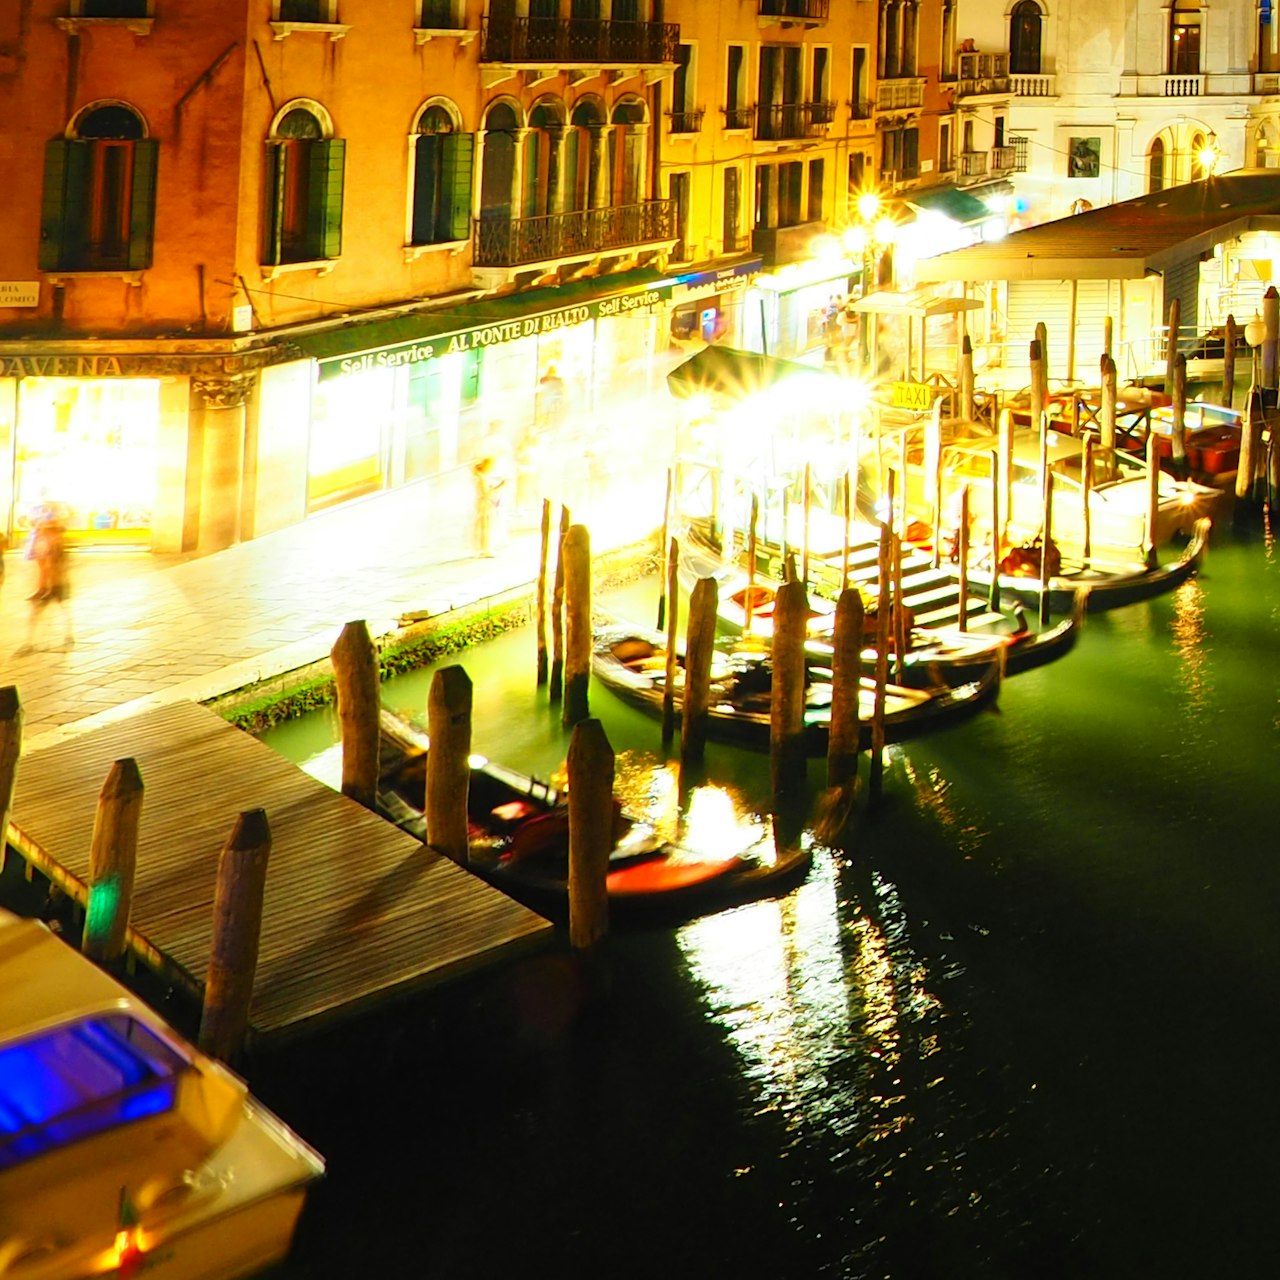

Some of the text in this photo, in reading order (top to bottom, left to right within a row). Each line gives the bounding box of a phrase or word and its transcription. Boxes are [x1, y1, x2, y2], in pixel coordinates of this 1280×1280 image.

[340, 290, 660, 374] Self Service AL PONTE DI RIALTO Self Service
[897, 385, 926, 406] TAXI
